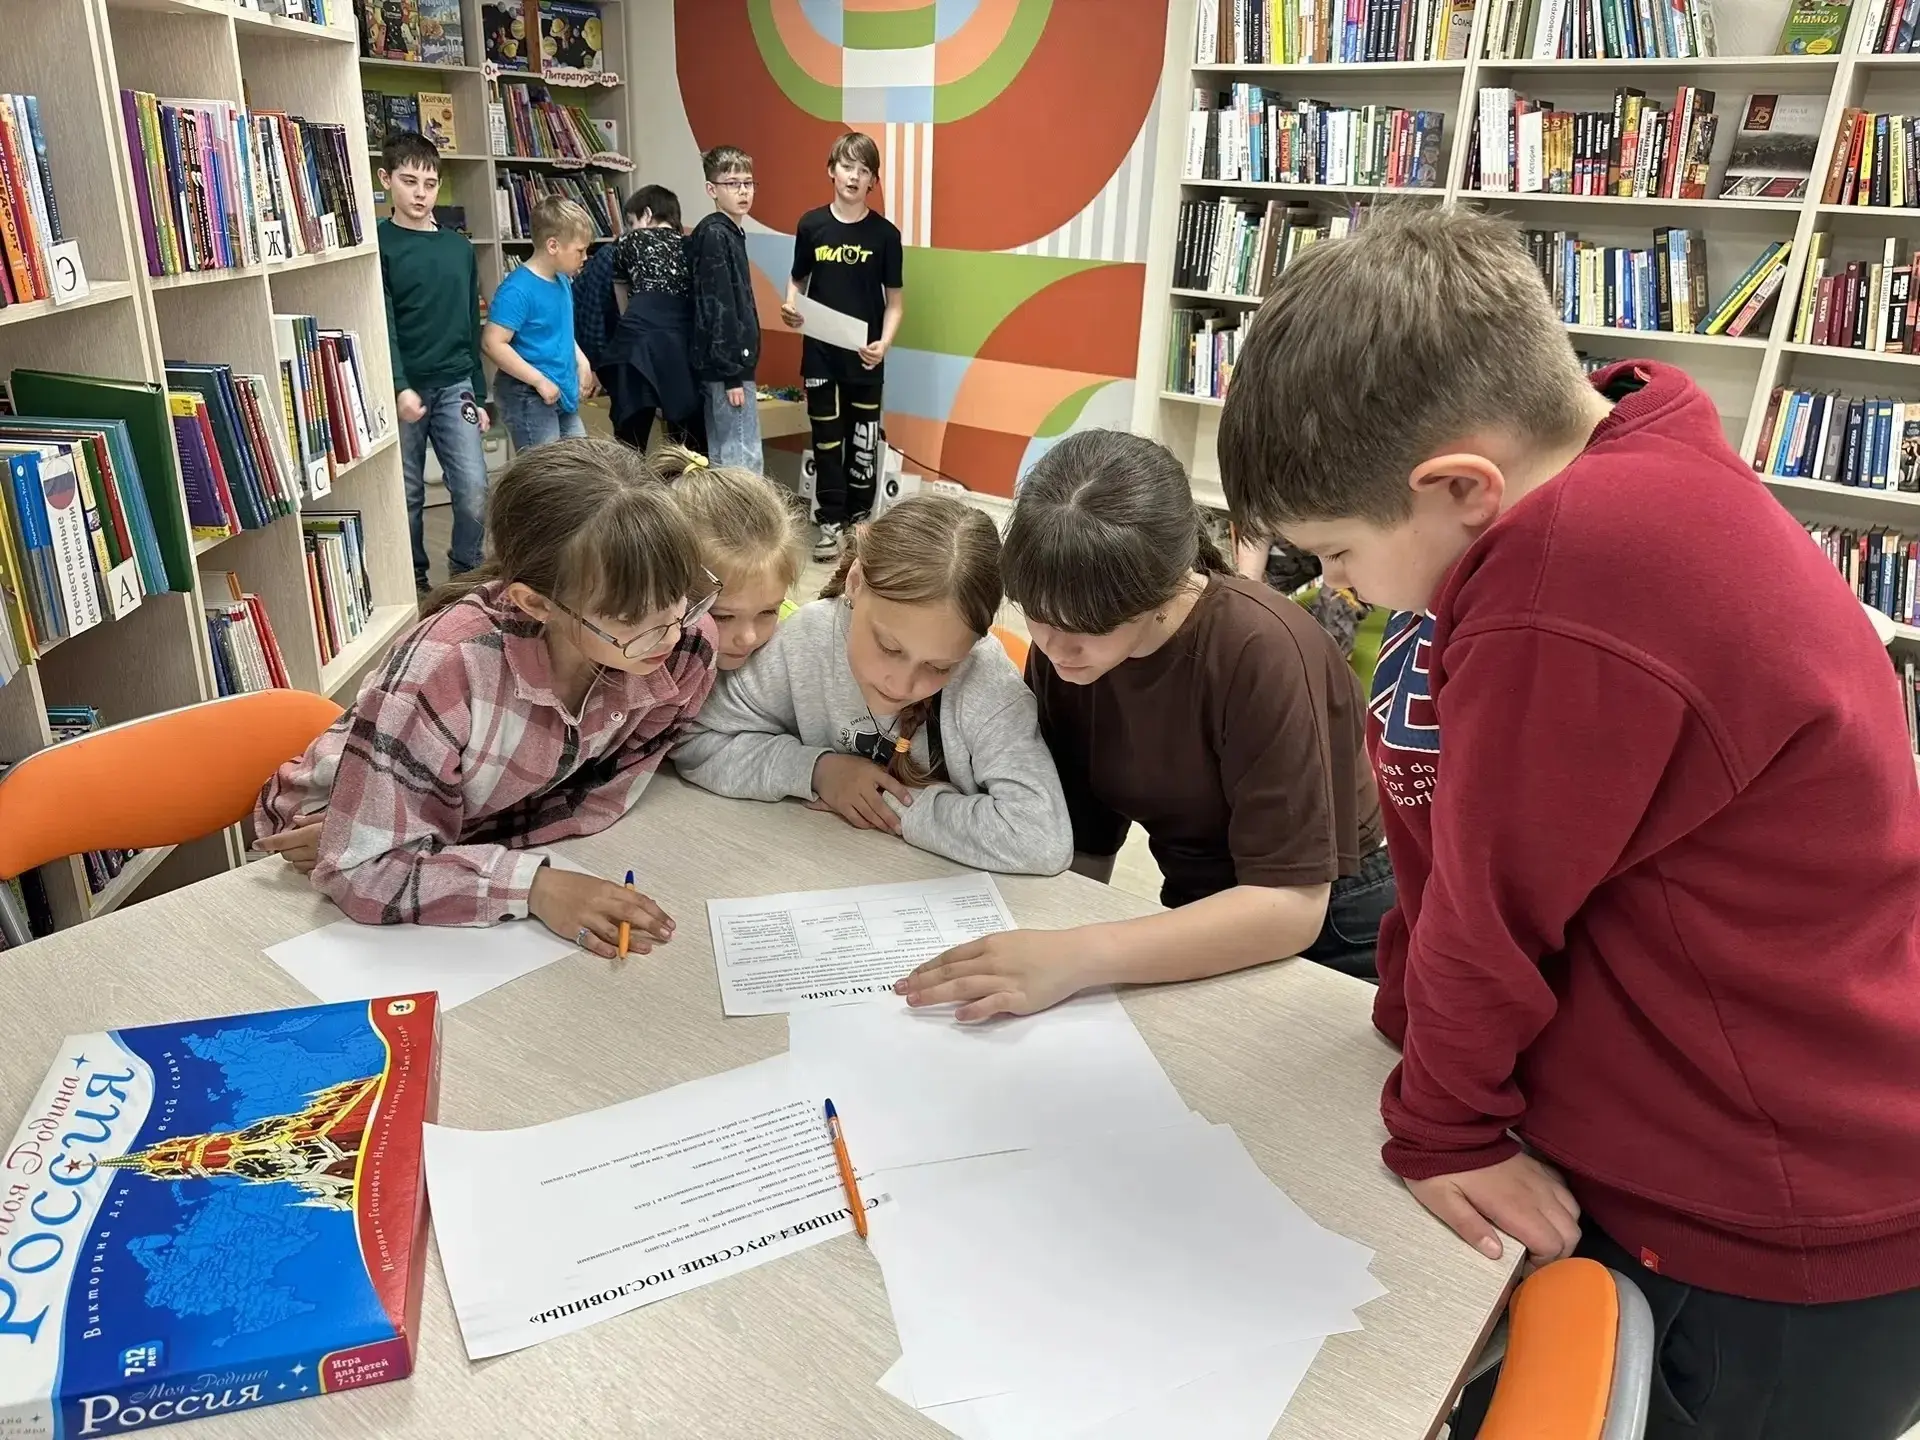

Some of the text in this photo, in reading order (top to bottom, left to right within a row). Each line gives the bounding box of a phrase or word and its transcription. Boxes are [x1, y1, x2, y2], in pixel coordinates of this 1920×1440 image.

[1793, 12, 1838, 24] мамой
[485, 65, 497, 75] 0+
[544, 70, 617, 83] Литература для
[1281, 131, 1290, 167] МОСКВА
[5, 171, 16, 205] РАДИО
[266, 228, 284, 258] Ж
[325, 221, 335, 247] И
[814, 244, 873, 264] ПИЛОТ
[56, 256, 77, 292] Э
[376, 408, 388, 428] К
[314, 466, 328, 492] С
[68, 505, 93, 571] писатели
[57, 516, 84, 627] Отечественные
[82, 574, 98, 624] детские
[119, 578, 137, 611] А
[1411, 763, 1435, 773] do
[801, 987, 876, 1000] ЗАГАДКИ»
[383, 1078, 407, 1121] Культура
[6, 1075, 80, 1176] Родина
[373, 1130, 389, 1158] Наука
[0, 1067, 135, 1345] Россия
[84, 1051, 180, 1339] Викторина для всей семьи
[368, 1169, 381, 1218] География
[380, 1228, 394, 1272] История
[529, 1197, 881, 1324] САНЦИЯ 4 «РУССКИЕ ПОСЛОВИЦЫ»
[124, 1346, 147, 1378] 7-12
[147, 1345, 156, 1368] лет
[331, 1355, 361, 1370] Игра
[334, 1358, 389, 1379] для детей
[129, 1368, 269, 1405] Моя Родина
[337, 1370, 384, 1386] 7-12 лет
[79, 1384, 265, 1436] Россия
